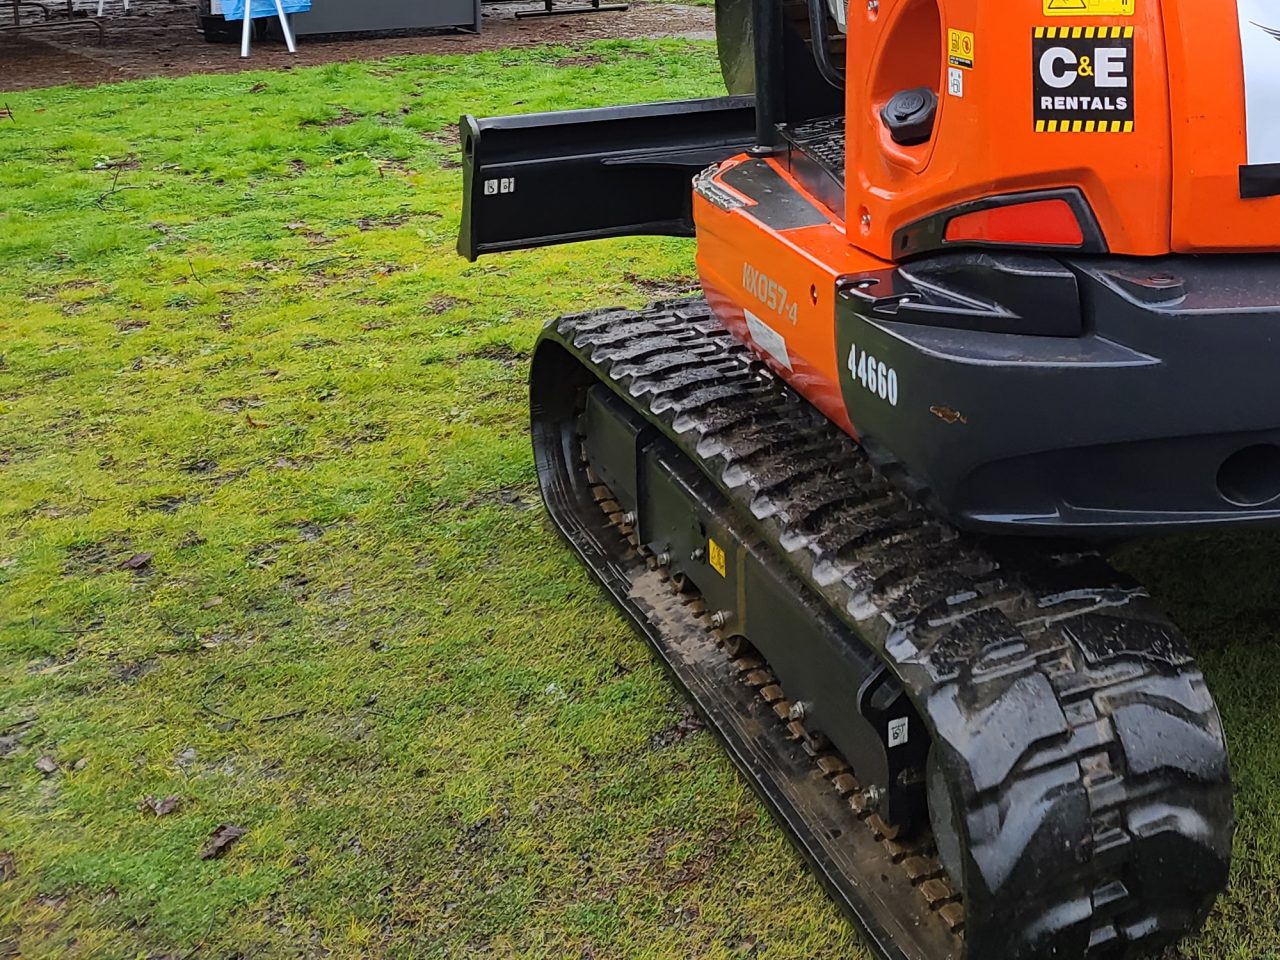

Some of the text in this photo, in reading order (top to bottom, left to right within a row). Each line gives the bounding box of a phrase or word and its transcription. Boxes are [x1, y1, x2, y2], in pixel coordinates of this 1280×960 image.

[1038, 46, 1128, 89] C&E
[1040, 96, 1128, 111] RENTALS
[847, 342, 898, 407] 44660
